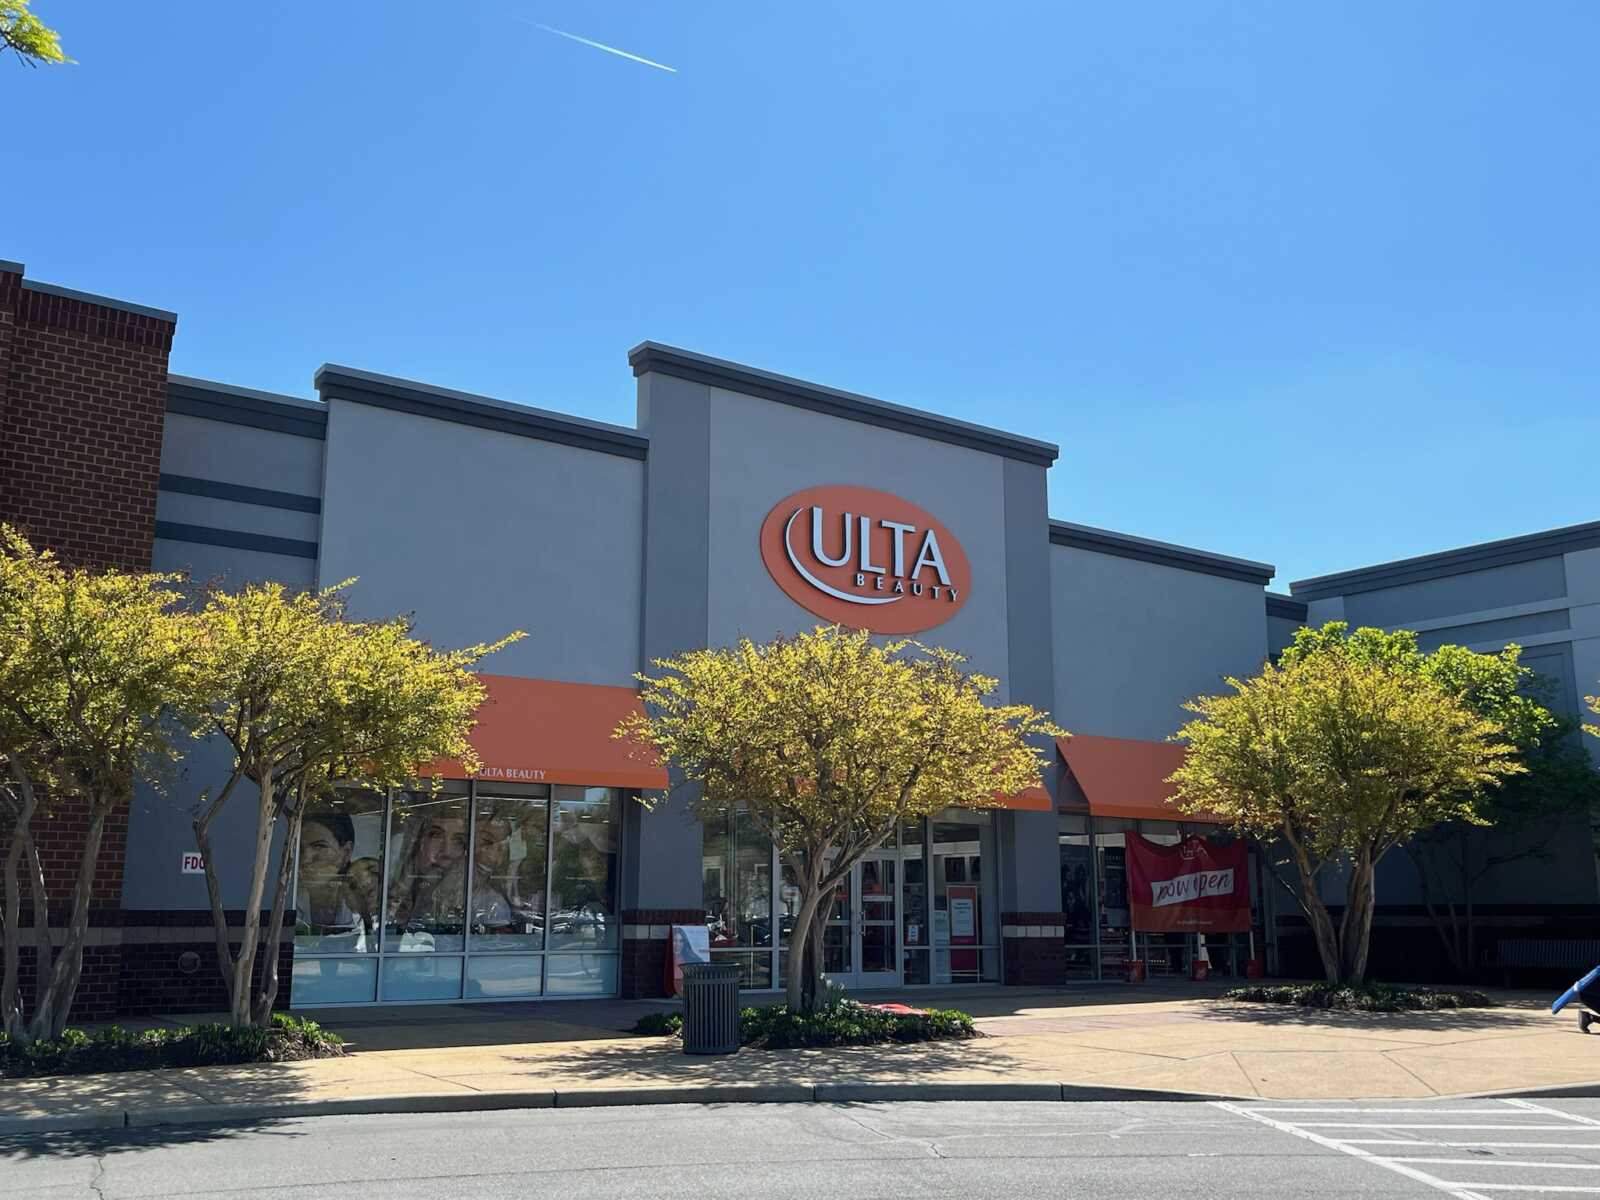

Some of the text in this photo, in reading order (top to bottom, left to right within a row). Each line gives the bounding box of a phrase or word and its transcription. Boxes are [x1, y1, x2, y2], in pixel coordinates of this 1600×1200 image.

[812, 505, 952, 585] ULTA
[855, 573, 960, 602] BEAUTY
[506, 768, 546, 780] BEAUTY
[1157, 880, 1190, 902] now
